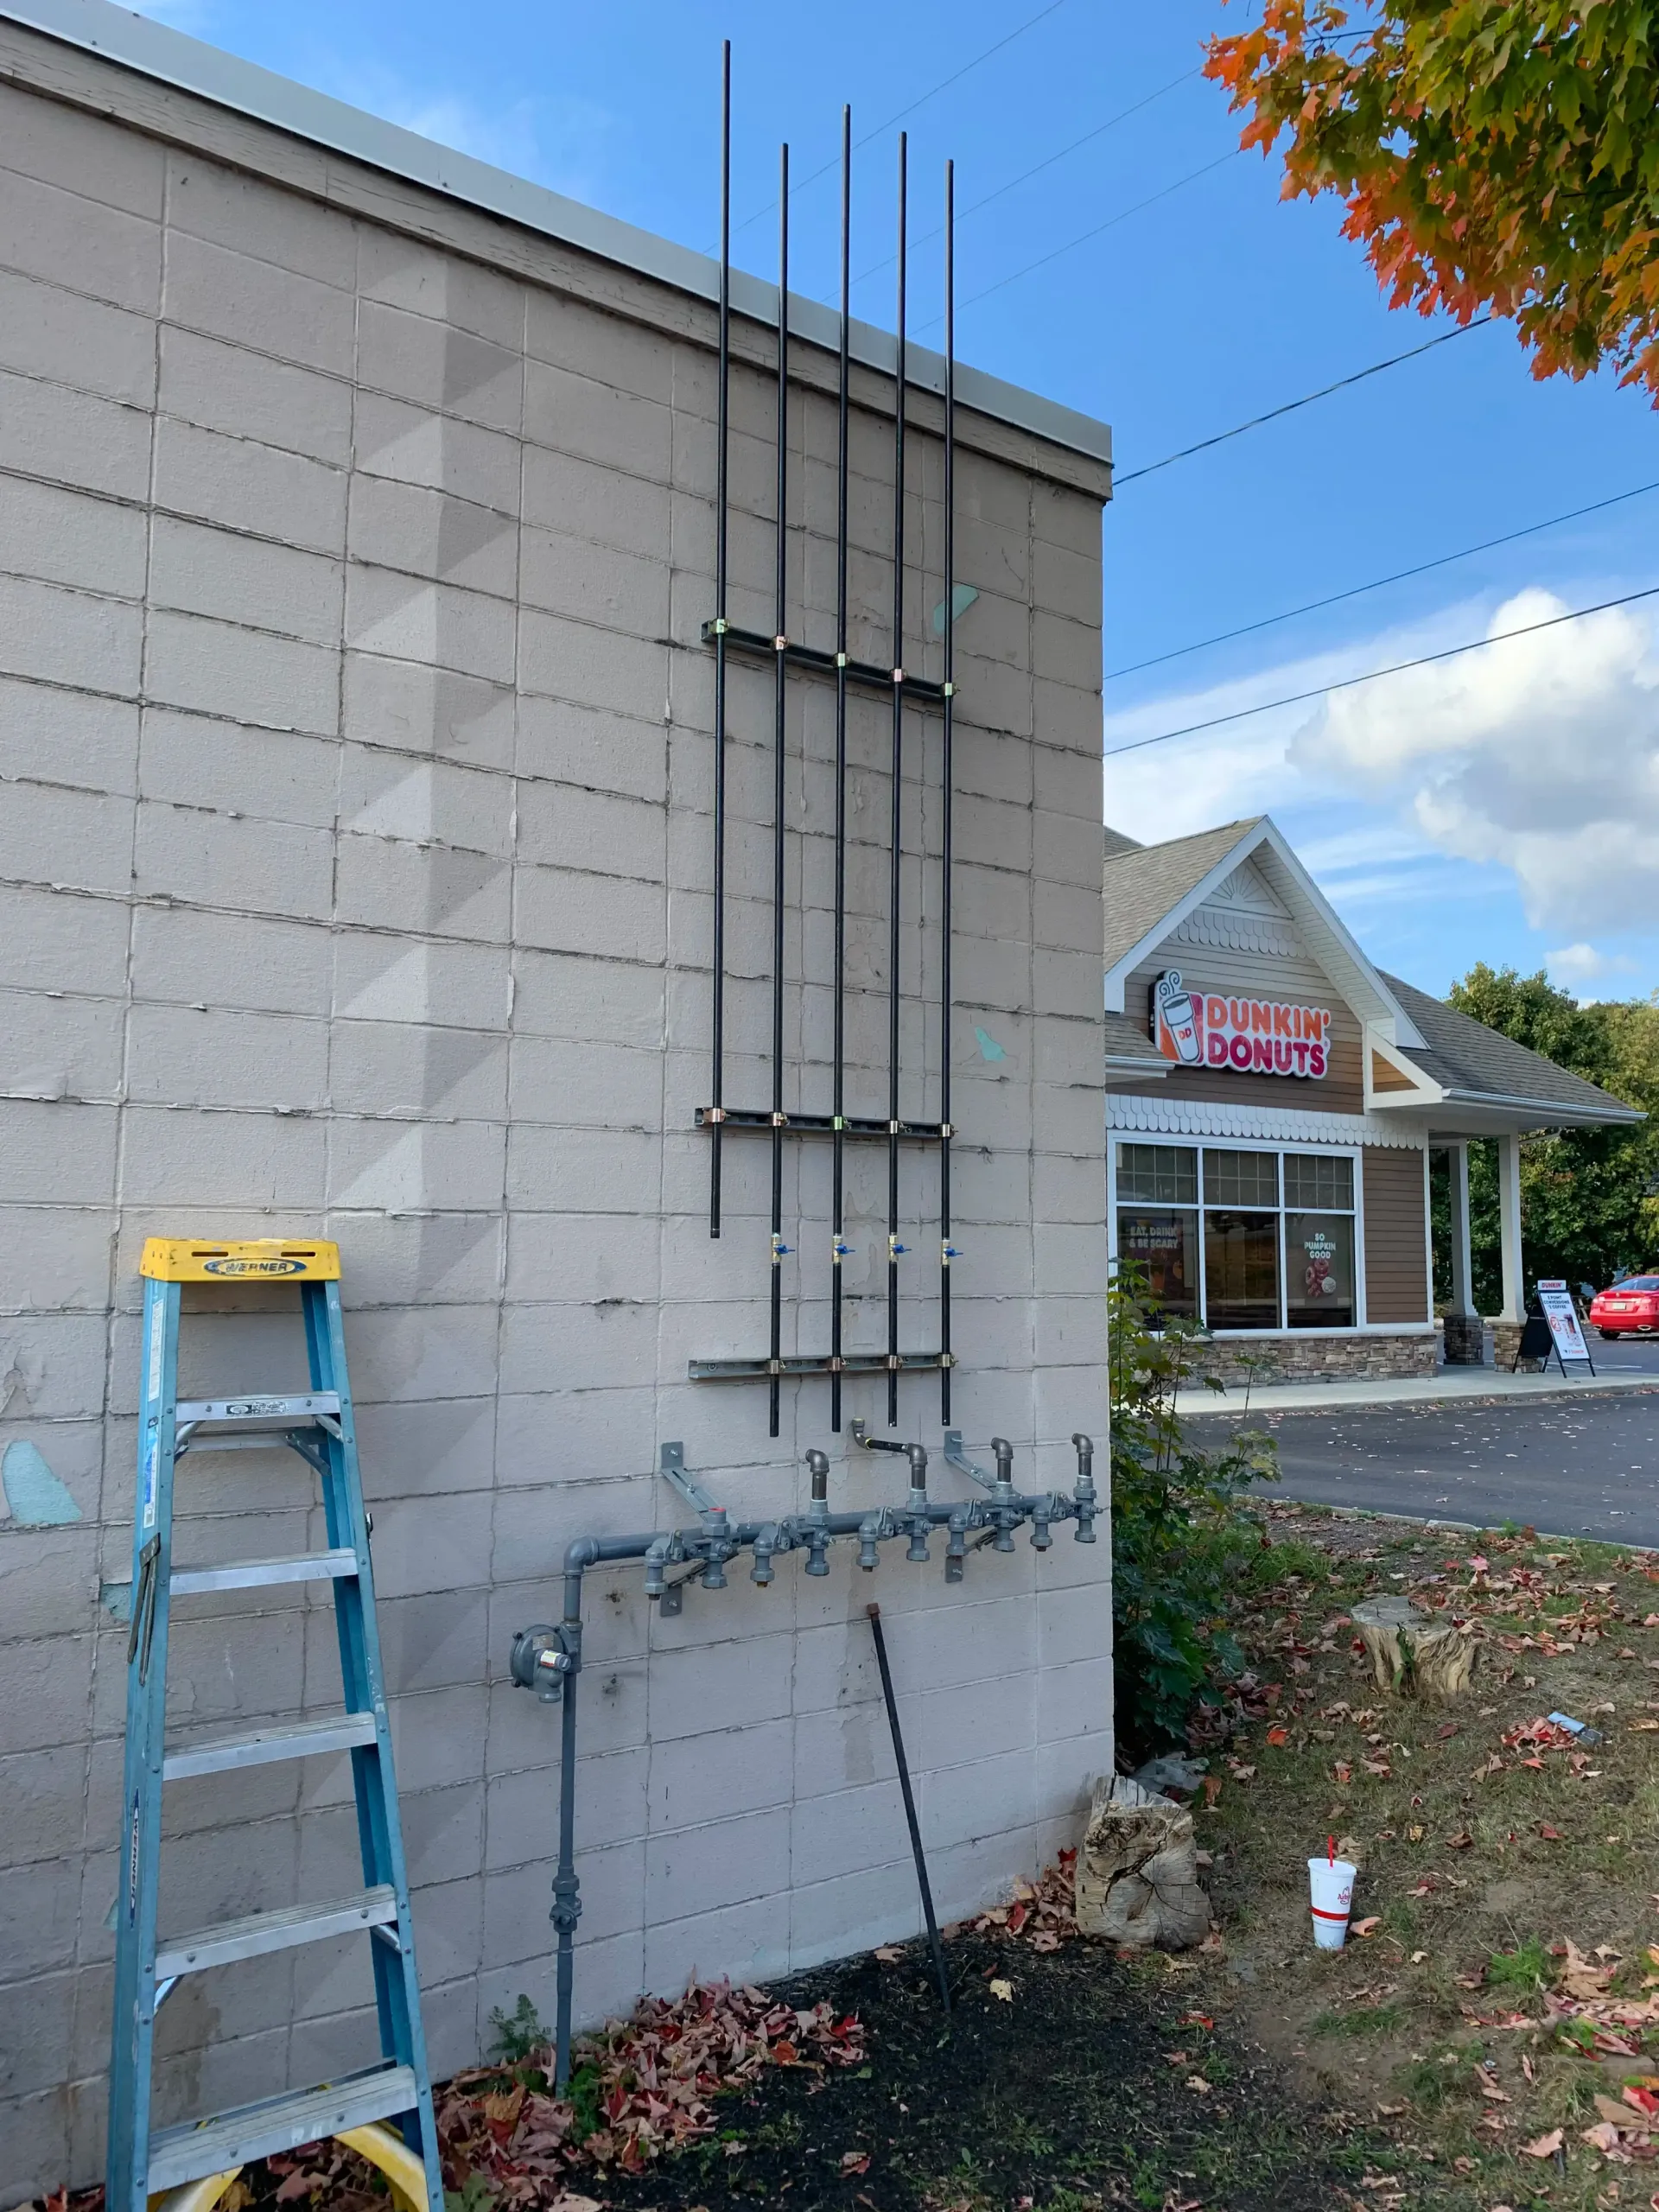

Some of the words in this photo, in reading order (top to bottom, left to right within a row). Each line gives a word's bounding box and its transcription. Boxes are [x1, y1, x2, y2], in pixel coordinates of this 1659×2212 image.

[1207, 997, 1329, 1041] DUNKIN'
[1178, 1027, 1192, 1040] DD
[1207, 1033, 1325, 1075] DONUTS
[1130, 1226, 1148, 1237] EAT,
[1150, 1226, 1177, 1237] DRINK
[1138, 1238, 1149, 1248] BE
[1150, 1238, 1178, 1249] SCARY
[1304, 1242, 1336, 1250] PUMPKIN
[226, 1262, 288, 1273] WERNER
